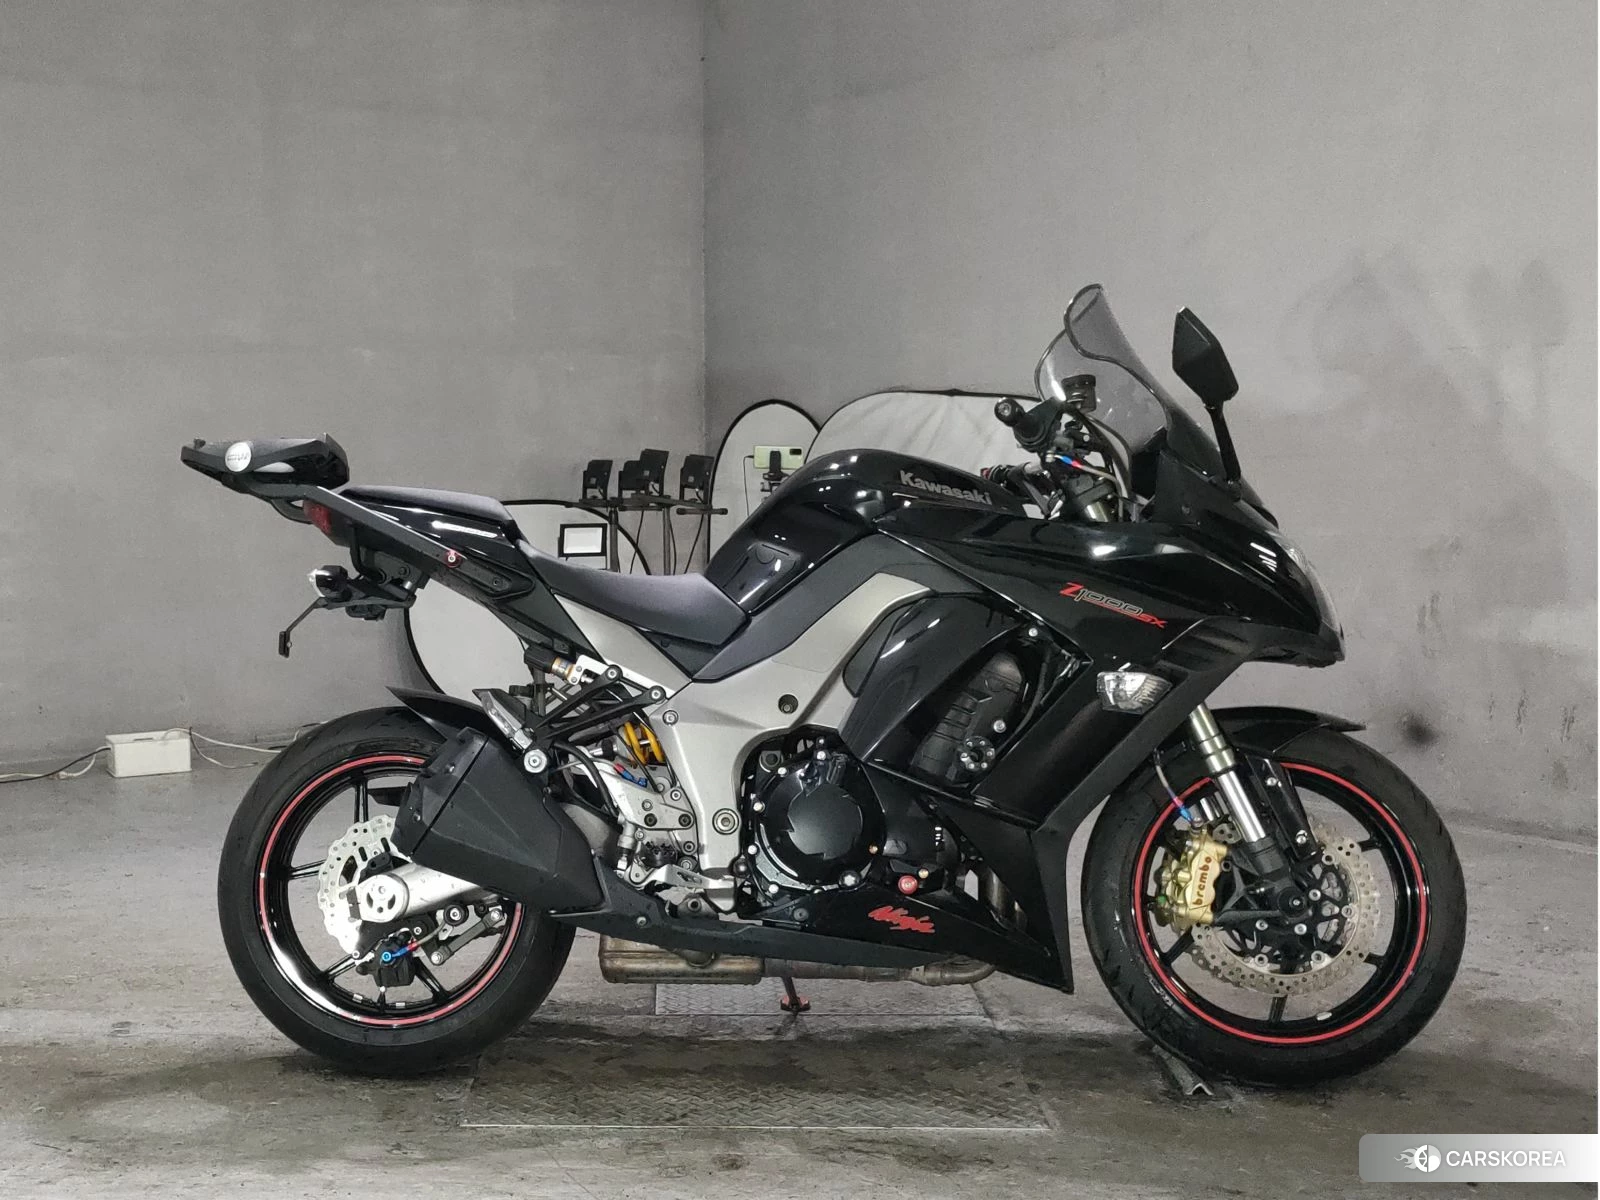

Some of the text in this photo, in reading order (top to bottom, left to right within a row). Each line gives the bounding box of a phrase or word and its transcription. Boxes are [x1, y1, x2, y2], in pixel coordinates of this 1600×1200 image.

[900, 470, 992, 505] Kawasaki
[1192, 856, 1212, 905] brembo
[868, 905, 935, 933] Ninja
